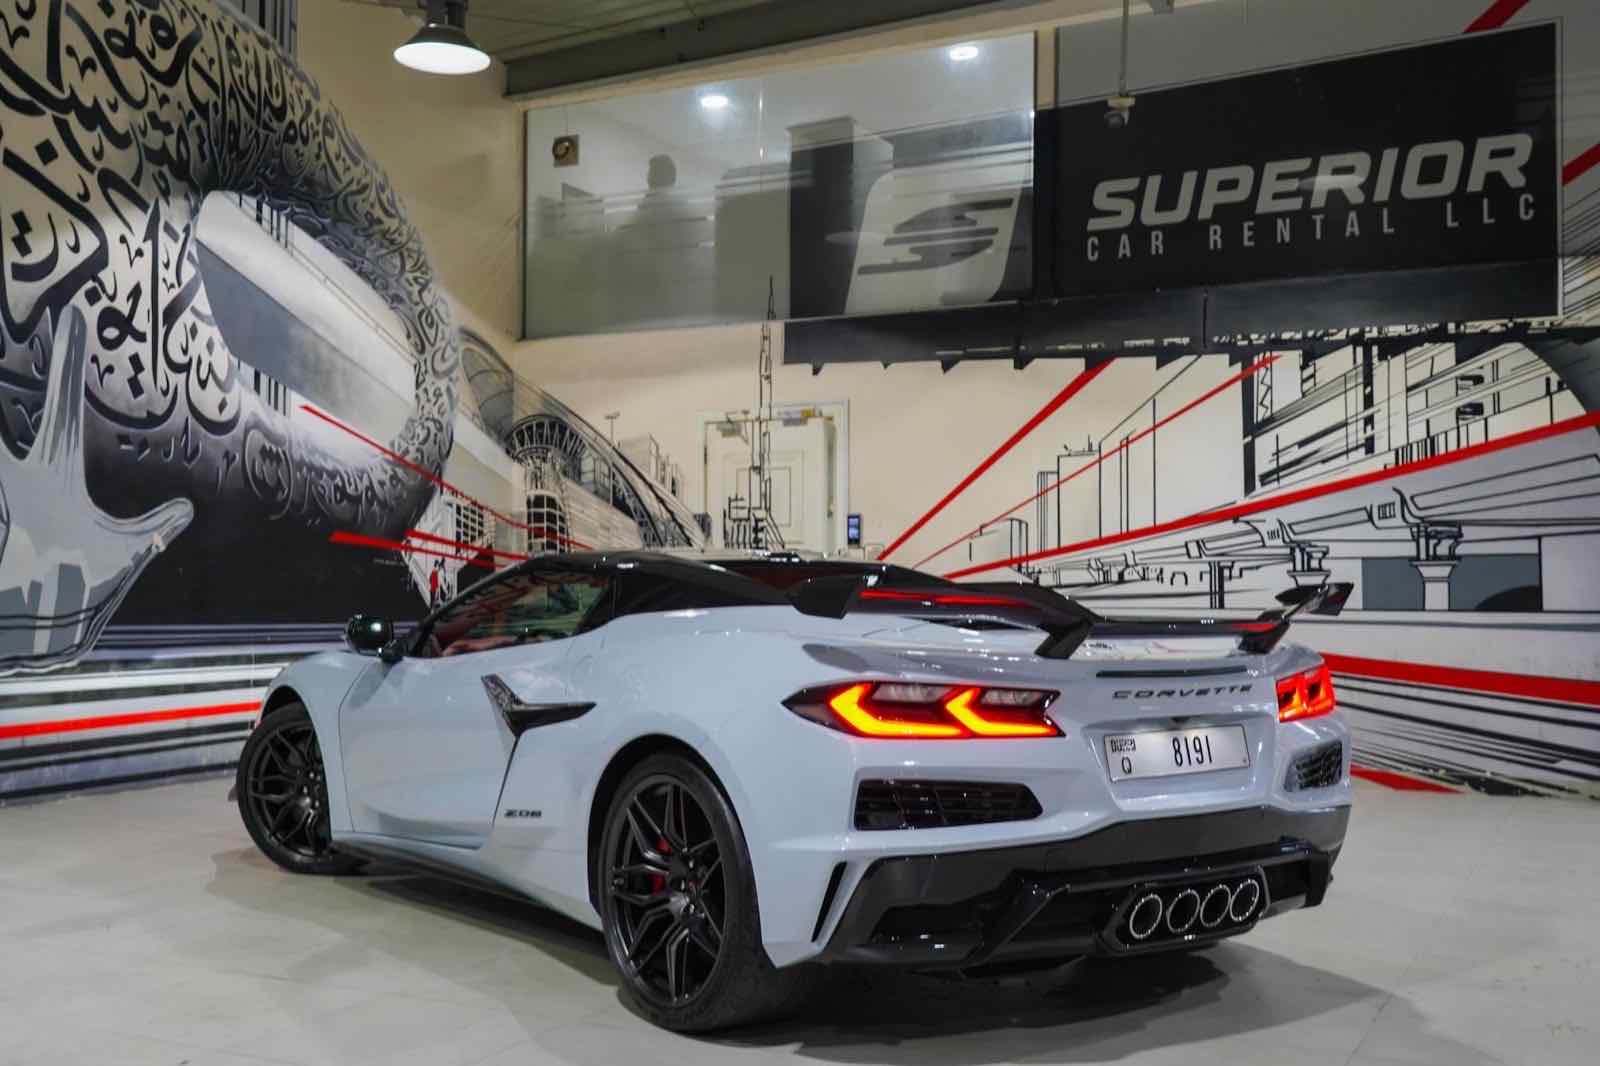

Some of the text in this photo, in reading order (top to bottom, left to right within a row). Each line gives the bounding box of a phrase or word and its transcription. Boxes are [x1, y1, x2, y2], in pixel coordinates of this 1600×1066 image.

[1086, 132, 1534, 231] SUPERIOR
[1086, 193, 1535, 262] CAR RENTAL LLC
[1112, 684, 1254, 700] CORVETTE
[1121, 756, 1132, 775] Q
[1172, 735, 1213, 768] 8191
